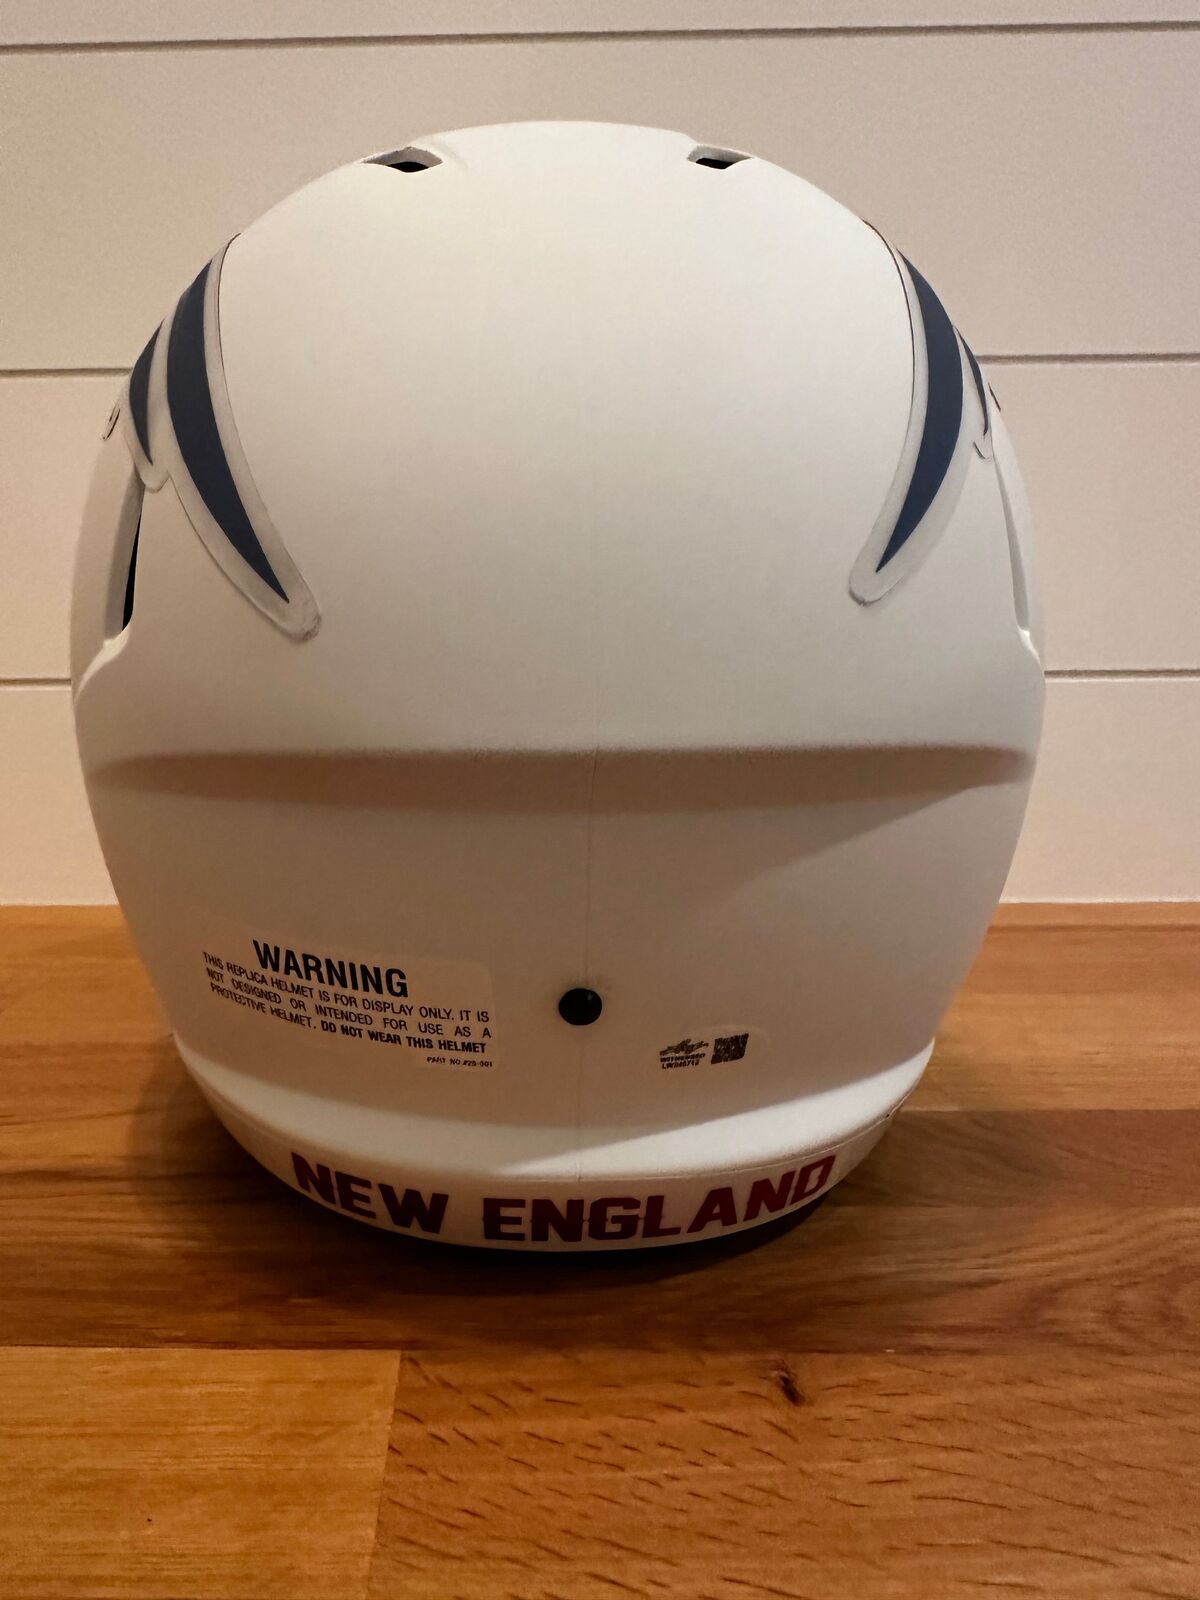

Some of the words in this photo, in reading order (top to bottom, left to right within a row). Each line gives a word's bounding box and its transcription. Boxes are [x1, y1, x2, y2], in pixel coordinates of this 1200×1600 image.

[203, 951, 224, 970] THIS
[226, 961, 268, 986] REPLICA
[271, 977, 314, 999] HELMET
[320, 989, 330, 1002] IS
[334, 993, 358, 1008] FOR
[362, 998, 414, 1016] DISPLAY
[419, 1006, 455, 1020] ONLY.
[460, 1009, 471, 1021] IT
[477, 1010, 489, 1022] IS
[206, 967, 224, 983] NOT
[232, 978, 282, 1004] DESIGNED
[290, 998, 307, 1012] OR
[315, 1004, 373, 1026] INTENDED
[383, 1018, 408, 1031] FOR
[418, 1022, 444, 1035] USE
[454, 1026, 471, 1037] AS
[482, 1027, 492, 1038] A
[253, 939, 408, 997] WARNING
[210, 982, 266, 1013] PROTECTIVE
[270, 1006, 317, 1029] HELMET.
[321, 1020, 337, 1033] DO
[341, 1024, 363, 1038] NOT
[368, 1030, 401, 1046] WEAR
[406, 1036, 434, 1049] THIS
[438, 1039, 487, 1053] HELMET
[291, 1152, 448, 1235] NEW
[483, 1155, 836, 1243] ENGLAND
